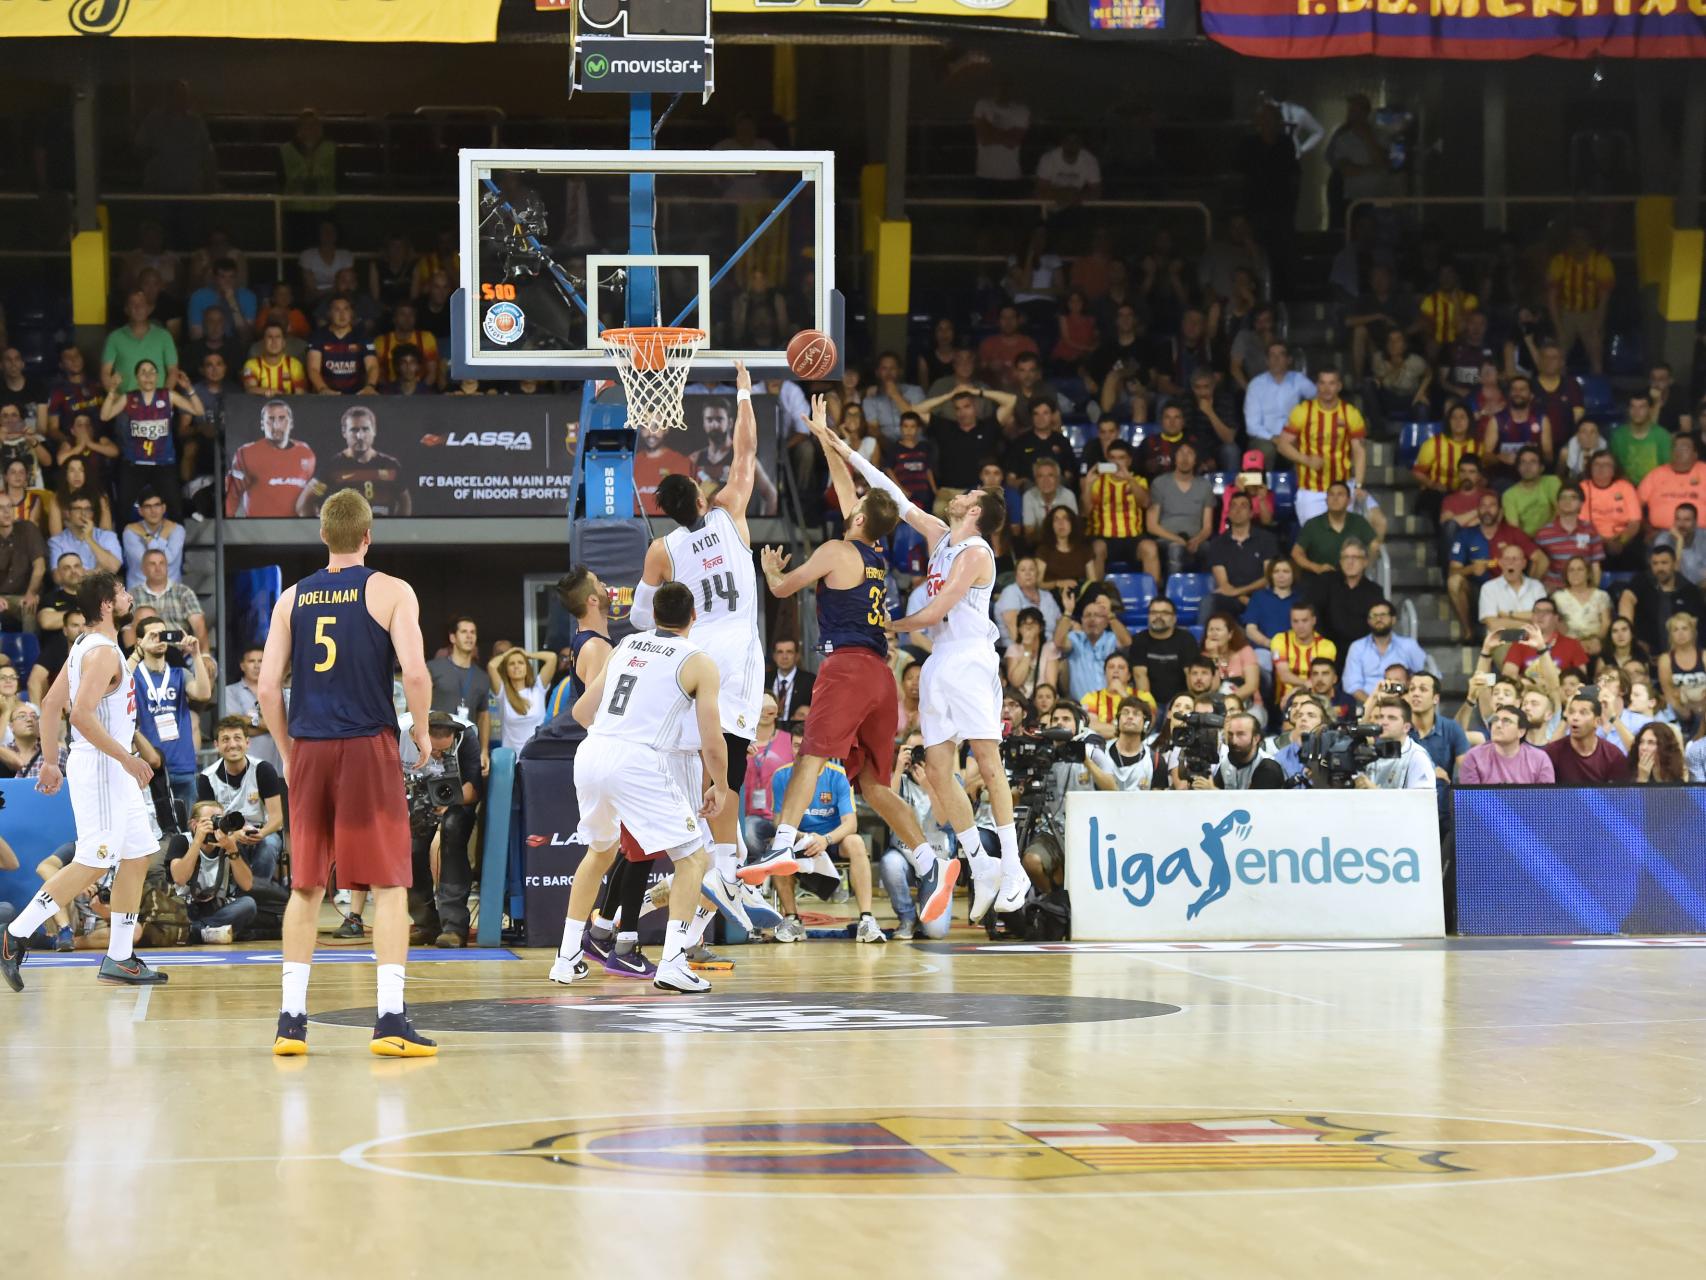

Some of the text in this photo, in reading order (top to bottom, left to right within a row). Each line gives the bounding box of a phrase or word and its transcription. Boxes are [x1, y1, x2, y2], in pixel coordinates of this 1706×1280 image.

[611, 58, 702, 73] movistar+
[130, 419, 168, 440] Regal
[446, 431, 532, 447] LASSA
[142, 441, 154, 456] 4
[419, 475, 572, 487] FC BARCELONA MAIN PAR
[454, 488, 568, 500] OF INDOOR SPORTS
[604, 467, 615, 515] MONDO
[297, 588, 359, 608] DOELLMAN
[701, 571, 740, 612] 14
[314, 616, 337, 673] 5
[607, 673, 638, 716] 8
[803, 807, 835, 816] ASSA
[1089, 816, 1421, 907] liga endesa
[525, 876, 540, 887] FC
[543, 876, 575, 886] BARC
